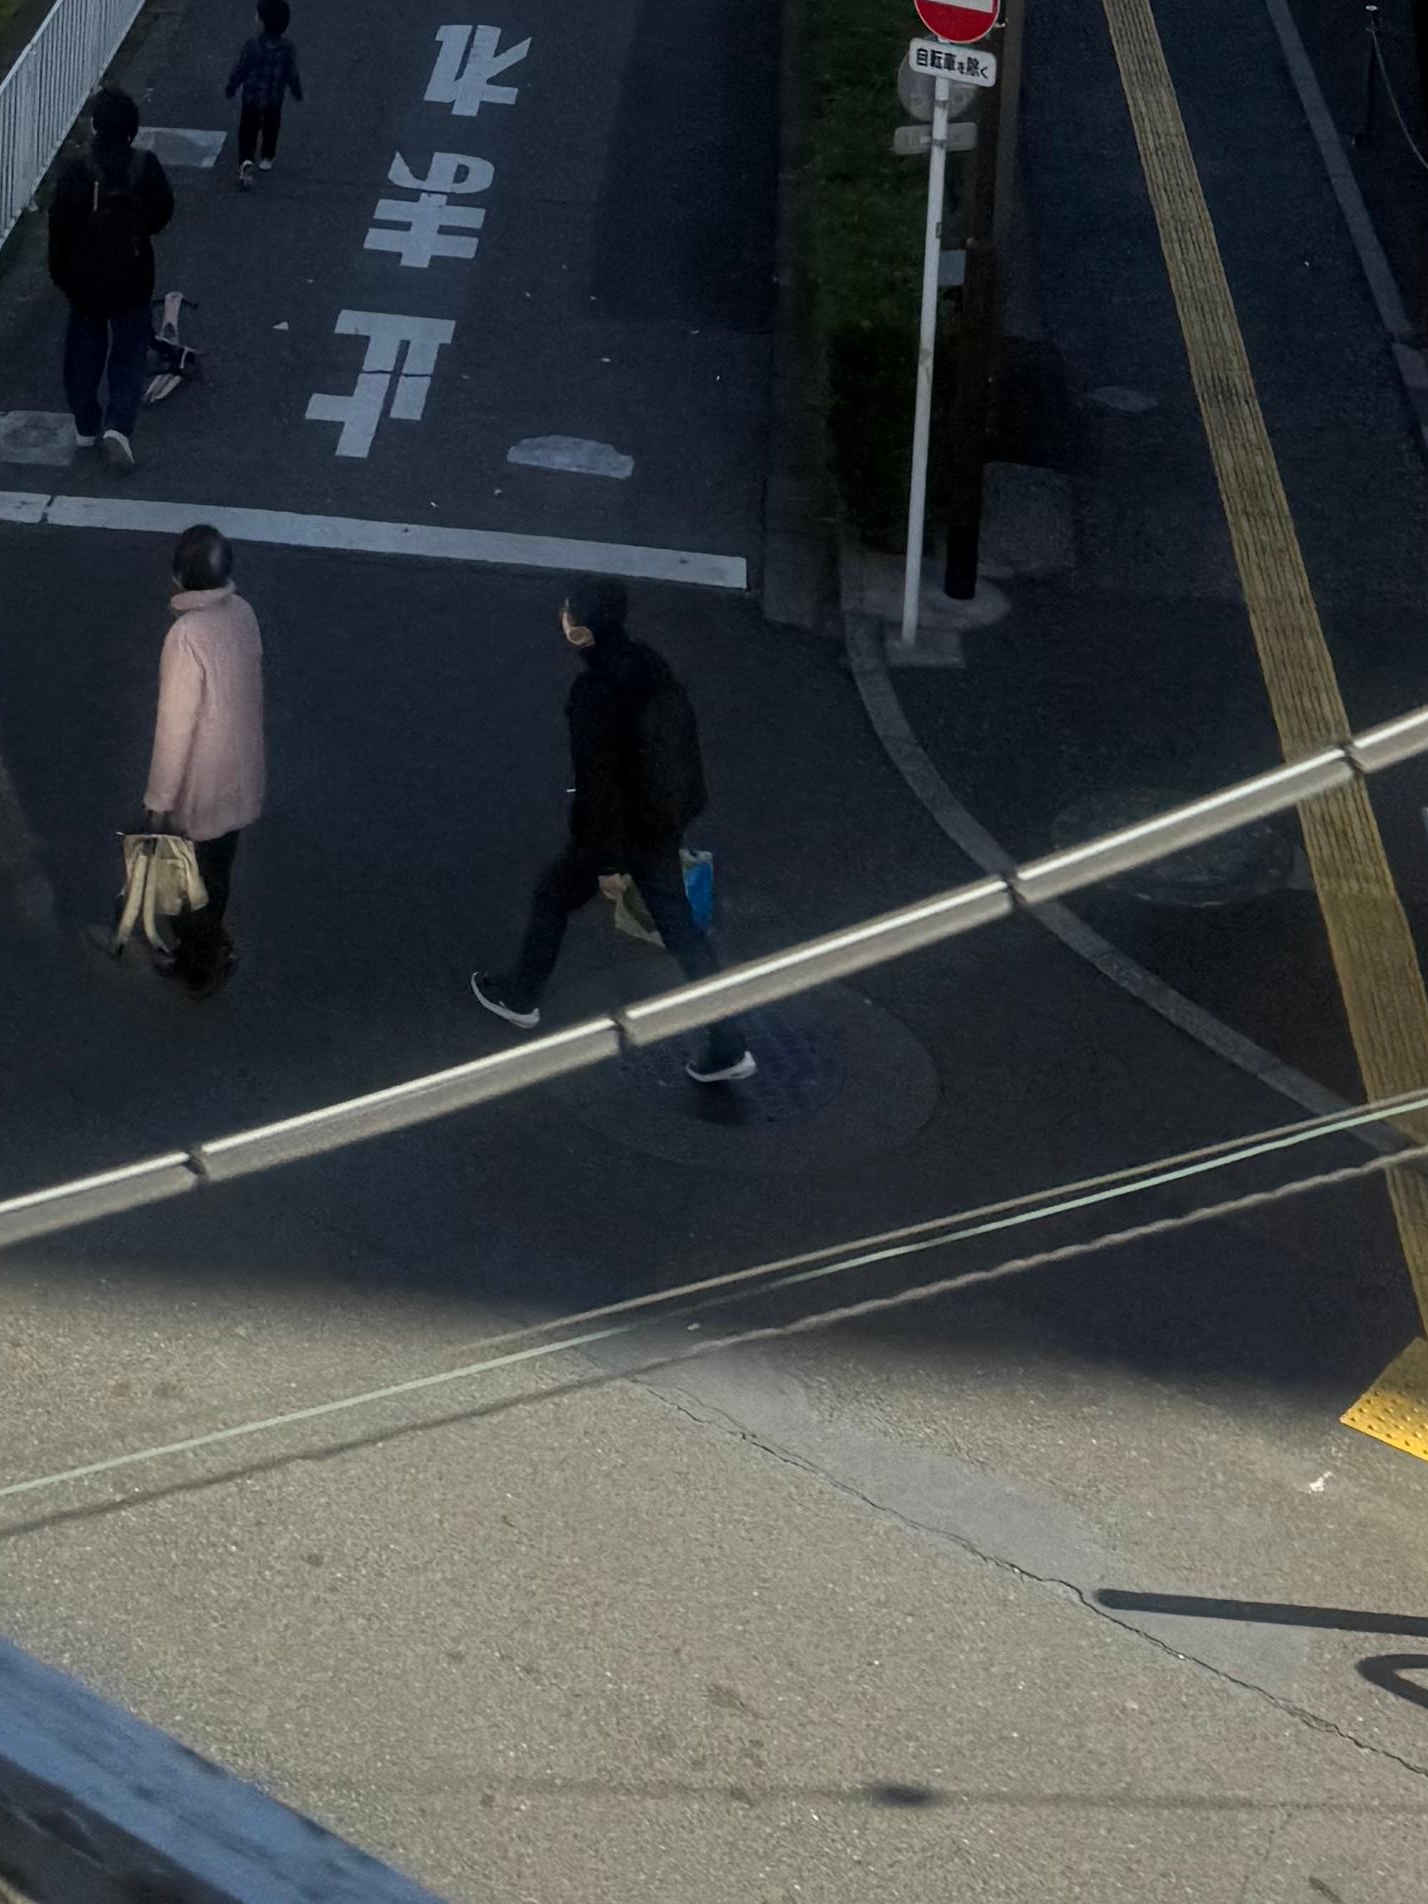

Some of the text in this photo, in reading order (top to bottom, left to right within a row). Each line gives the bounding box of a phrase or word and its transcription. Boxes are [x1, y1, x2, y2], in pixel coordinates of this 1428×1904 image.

[916, 48, 988, 79] 自転車を除く
[305, 24, 532, 458] 止まれ
